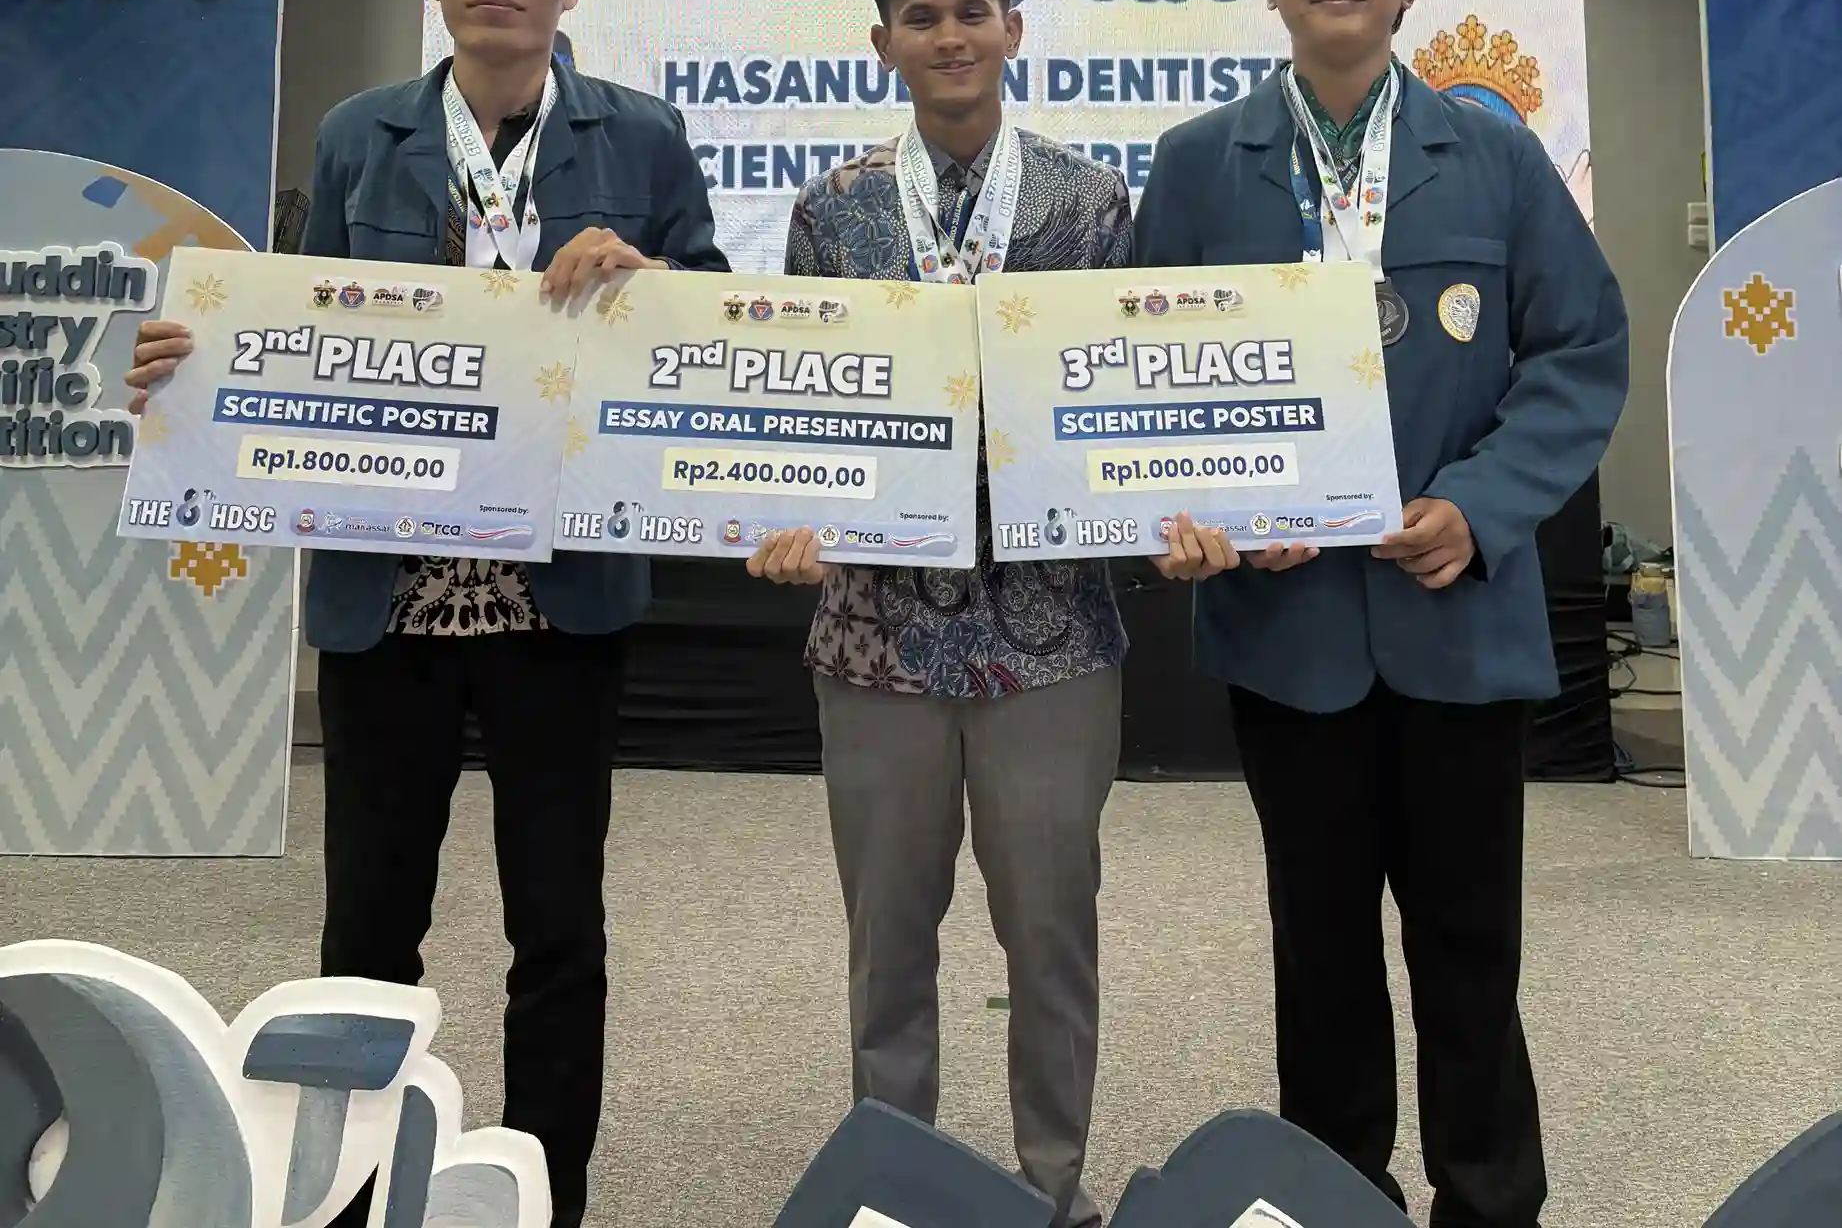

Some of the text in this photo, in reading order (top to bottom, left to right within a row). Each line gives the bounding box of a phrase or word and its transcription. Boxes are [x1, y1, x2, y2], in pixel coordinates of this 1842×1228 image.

[664, 58, 1291, 103] HASANUN DENTIST
[373, 293, 404, 302] APDSA
[230, 326, 486, 390] 2nd PLACE
[650, 340, 892, 399] 2nd PLACE
[1061, 337, 1295, 390] 3rd PLACE
[221, 395, 489, 433] SCIENTIFIC POSTER
[606, 408, 946, 442] ESSAY ORAL PRESENTATION
[1061, 405, 1316, 434] SCIENTIFIC POSTER
[251, 448, 445, 479] Rp1.800.000,00
[673, 460, 866, 487] Rp2.400.000,00
[1101, 454, 1285, 486] Rp1.000.000,00
[1326, 493, 1362, 502] Sponsored
[129, 499, 172, 526] THE
[209, 503, 276, 532] HDSC
[562, 512, 602, 538] THE
[640, 516, 703, 543] HDSC
[899, 512, 936, 521] Sponsored
[999, 522, 1040, 548] THE
[1076, 519, 1138, 544] HDSC
